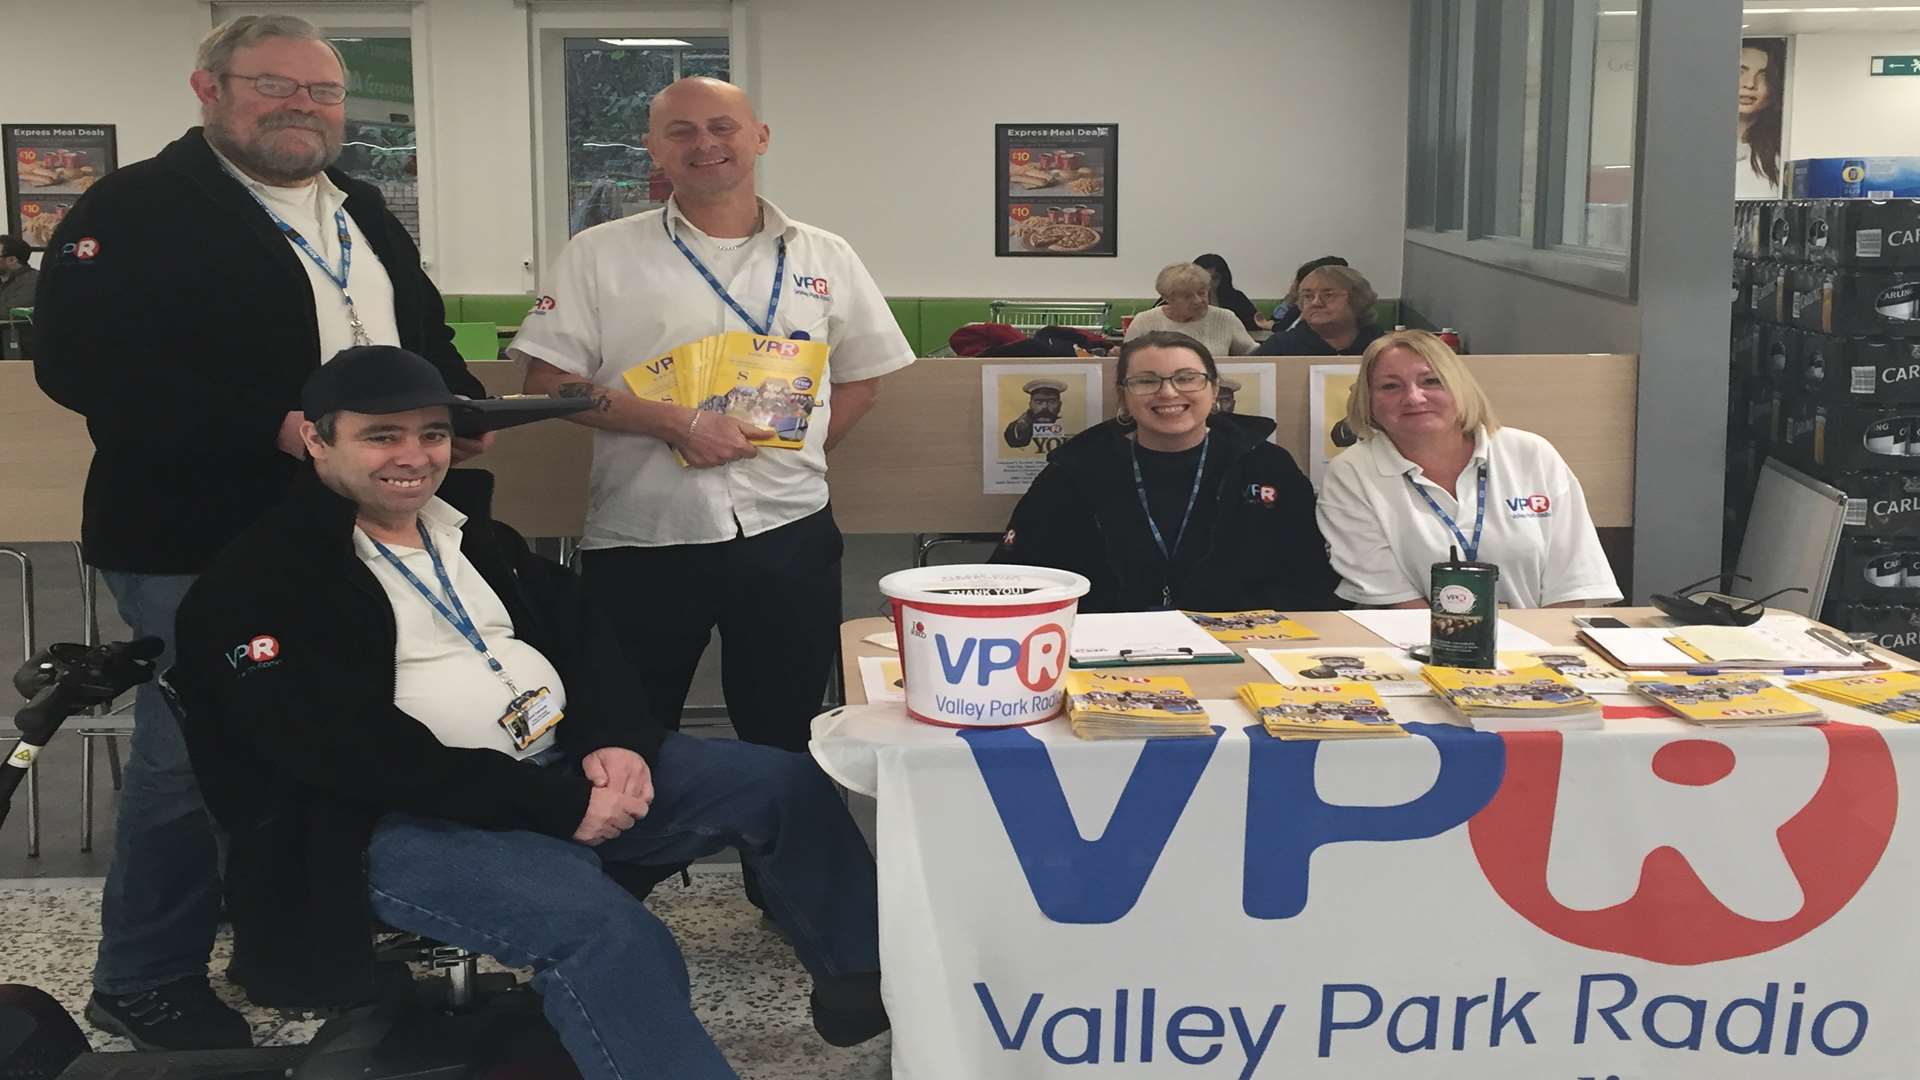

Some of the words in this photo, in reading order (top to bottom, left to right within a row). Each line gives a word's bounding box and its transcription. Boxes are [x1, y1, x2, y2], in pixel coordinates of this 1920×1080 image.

[14, 129, 51, 137] Express
[53, 128, 76, 136] Meal
[1007, 129, 1047, 137] Express
[1012, 151, 1030, 161] £10
[1012, 207, 1029, 217] £10
[60, 237, 98, 259] PR
[793, 273, 829, 296] VPR
[752, 338, 800, 357] VPR
[646, 356, 674, 374] VP
[1032, 435, 1074, 454] YO
[1505, 495, 1551, 512] VPR
[948, 588, 989, 597] THANK
[996, 587, 1025, 596] YOU!
[1880, 631, 1920, 649] CAR
[225, 635, 280, 669] VPR
[934, 622, 1067, 693] VPR
[1339, 673, 1405, 681] YOU
[935, 694, 985, 721] Valley
[990, 699, 1029, 717] Park
[957, 718, 1898, 966] VPR
[973, 983, 1287, 1080] Valley
[1318, 977, 1541, 1058] Park
[1572, 972, 1869, 1057] Radio
